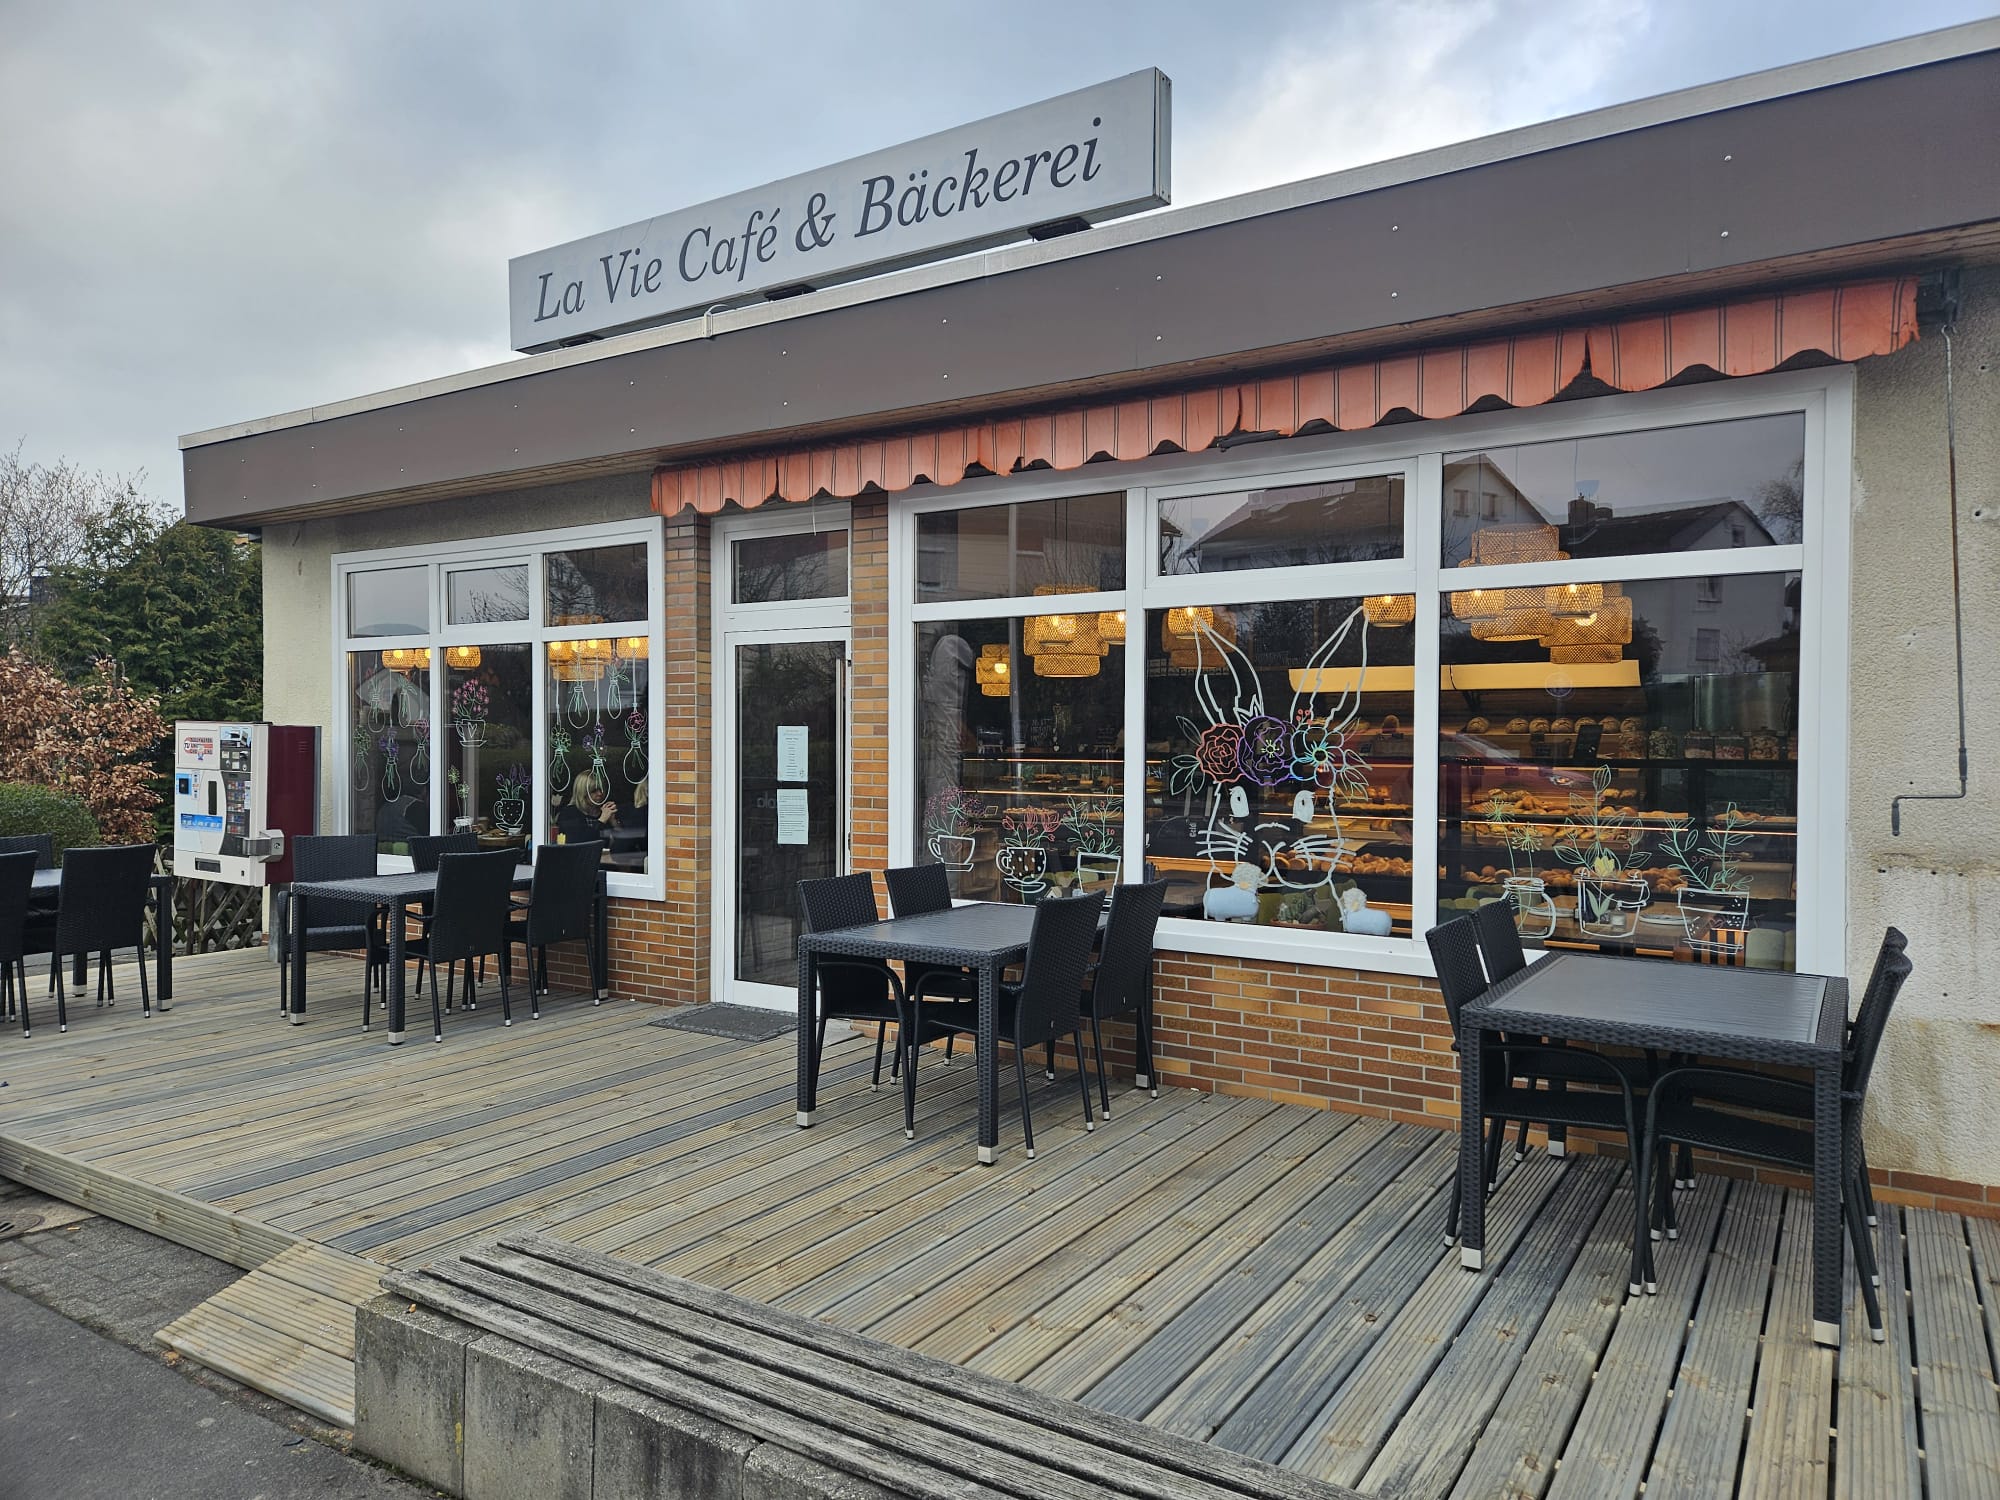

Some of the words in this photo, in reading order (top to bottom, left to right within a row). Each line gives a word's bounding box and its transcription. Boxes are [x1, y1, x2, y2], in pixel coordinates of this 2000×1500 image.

[533, 272, 586, 323] La
[599, 247, 663, 304] Vie
[678, 207, 782, 283] Café
[795, 192, 837, 252] &
[853, 116, 1103, 238] Bäckerei
